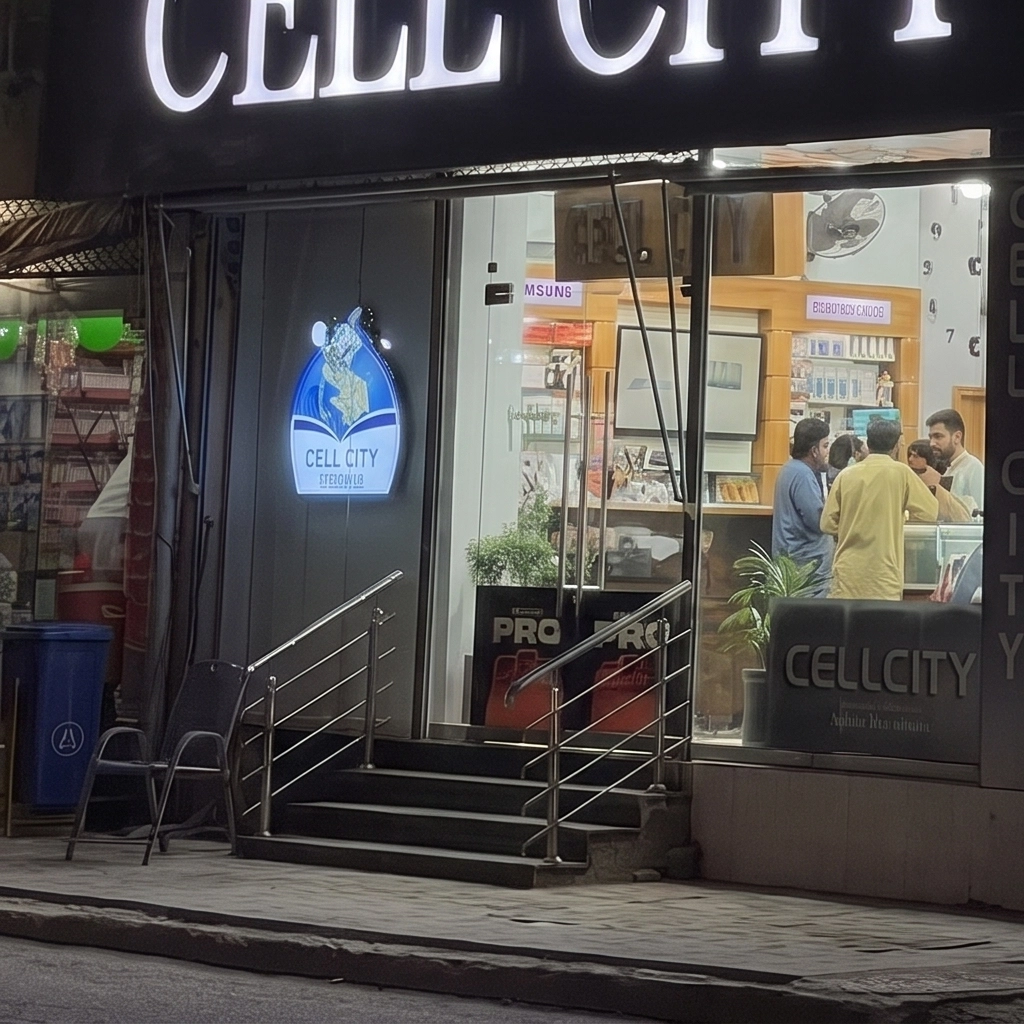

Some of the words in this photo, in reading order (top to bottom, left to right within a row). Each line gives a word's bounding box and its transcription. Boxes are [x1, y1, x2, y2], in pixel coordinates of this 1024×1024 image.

[305, 448, 341, 468] CELL
[345, 448, 379, 468] CITY
[492, 616, 561, 645] PRO
[785, 644, 977, 697] CELLCITY
